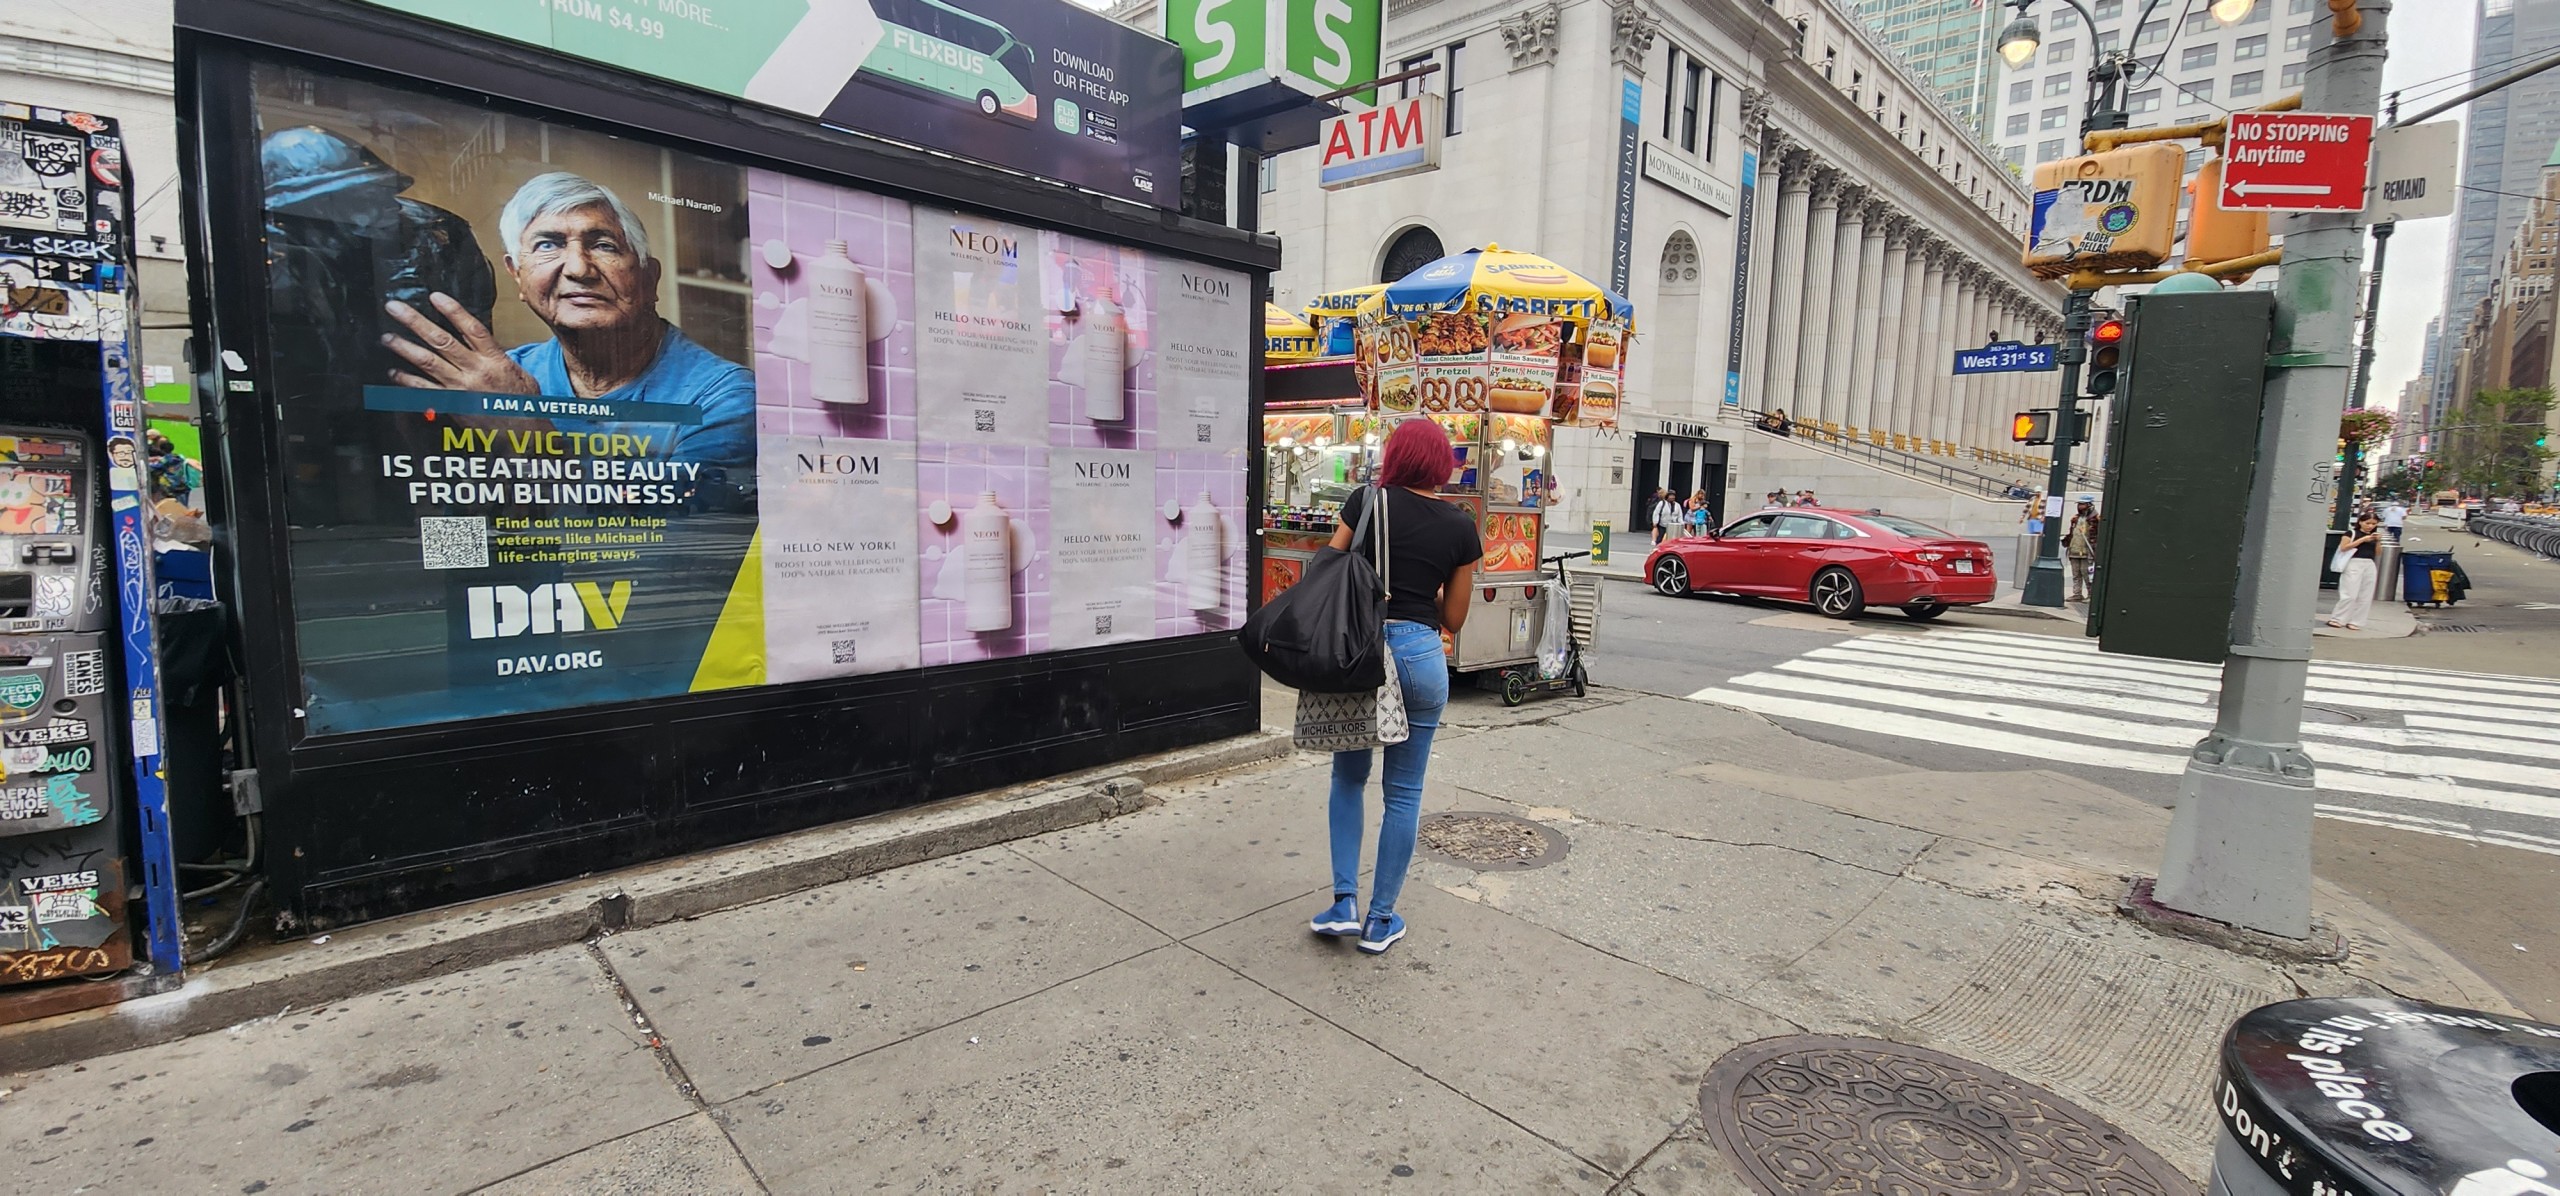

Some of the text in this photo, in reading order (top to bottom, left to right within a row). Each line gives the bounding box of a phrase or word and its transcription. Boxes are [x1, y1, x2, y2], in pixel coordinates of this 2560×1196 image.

[608, 5, 665, 39] $4.99
[1053, 48, 1114, 82] DOWNLOAD
[1053, 70, 1130, 107] OUR FREE APP
[1323, 100, 1424, 165] ATM
[2236, 122, 2350, 143] NO STOPPING
[1624, 131, 1635, 176] HALL
[2234, 145, 2306, 167] Anytime
[1648, 154, 1732, 206] MOYNIHAN TRAIN HALL
[2383, 177, 2426, 201] REMAND
[648, 191, 722, 214] Michael Naranjo
[1619, 180, 1632, 234] TRAIN
[950, 228, 1018, 259] NEOM
[1485, 264, 1555, 274] SABRETT
[1732, 193, 1752, 364] PENNSYLVANIA STATION
[820, 283, 853, 297] NEOM
[1181, 273, 1230, 298] NEOM
[1477, 294, 1597, 317] SABRETT
[935, 311, 1031, 332] HELLO NEW YORK!
[1093, 323, 1116, 333] NEOM
[1170, 342, 1238, 358] HELLO NEW YORK!
[1423, 355, 1439, 363] Halal
[1499, 353, 1550, 364] Italian Sausage
[1962, 351, 2045, 368] West 31st St
[1435, 367, 1471, 376] Pretzel
[1502, 366, 1518, 374] Best
[1541, 370, 1555, 378] Dog
[483, 398, 615, 417] I AM A VETERAN.
[1660, 420, 1710, 438] TO TRAINS
[442, 426, 652, 458] MY VICTORY
[382, 455, 701, 481] IS CREATING BEAUTY
[797, 453, 880, 475] NEOM
[1074, 462, 1130, 480] NEOM
[408, 482, 683, 505] FROM BLINDNESS.
[495, 515, 667, 530] Find out how DAV helps
[496, 531, 664, 546] veterans like Michael in
[973, 530, 1000, 539] NEOM
[1064, 535, 1091, 543] HELLO
[1115, 534, 1141, 542] YORK!
[498, 549, 641, 563] life-changing ways.
[783, 541, 897, 553] HELLO NEW YORK!
[774, 557, 905, 569] BOOST YOUR WELLBEING WITH
[780, 567, 901, 579] 100% NATURAL FRAGRANCES
[467, 580, 633, 640] DAV
[1519, 619, 1527, 632] A
[76, 652, 92, 694] LANES
[497, 650, 603, 676] DAV.ORG
[0, 683, 41, 695] ZECER
[5, 723, 88, 744] VEKS
[1301, 721, 1366, 736] MICHAEL KORS
[20, 870, 98, 890] VEKS
[2286, 1053, 2414, 1143] place
